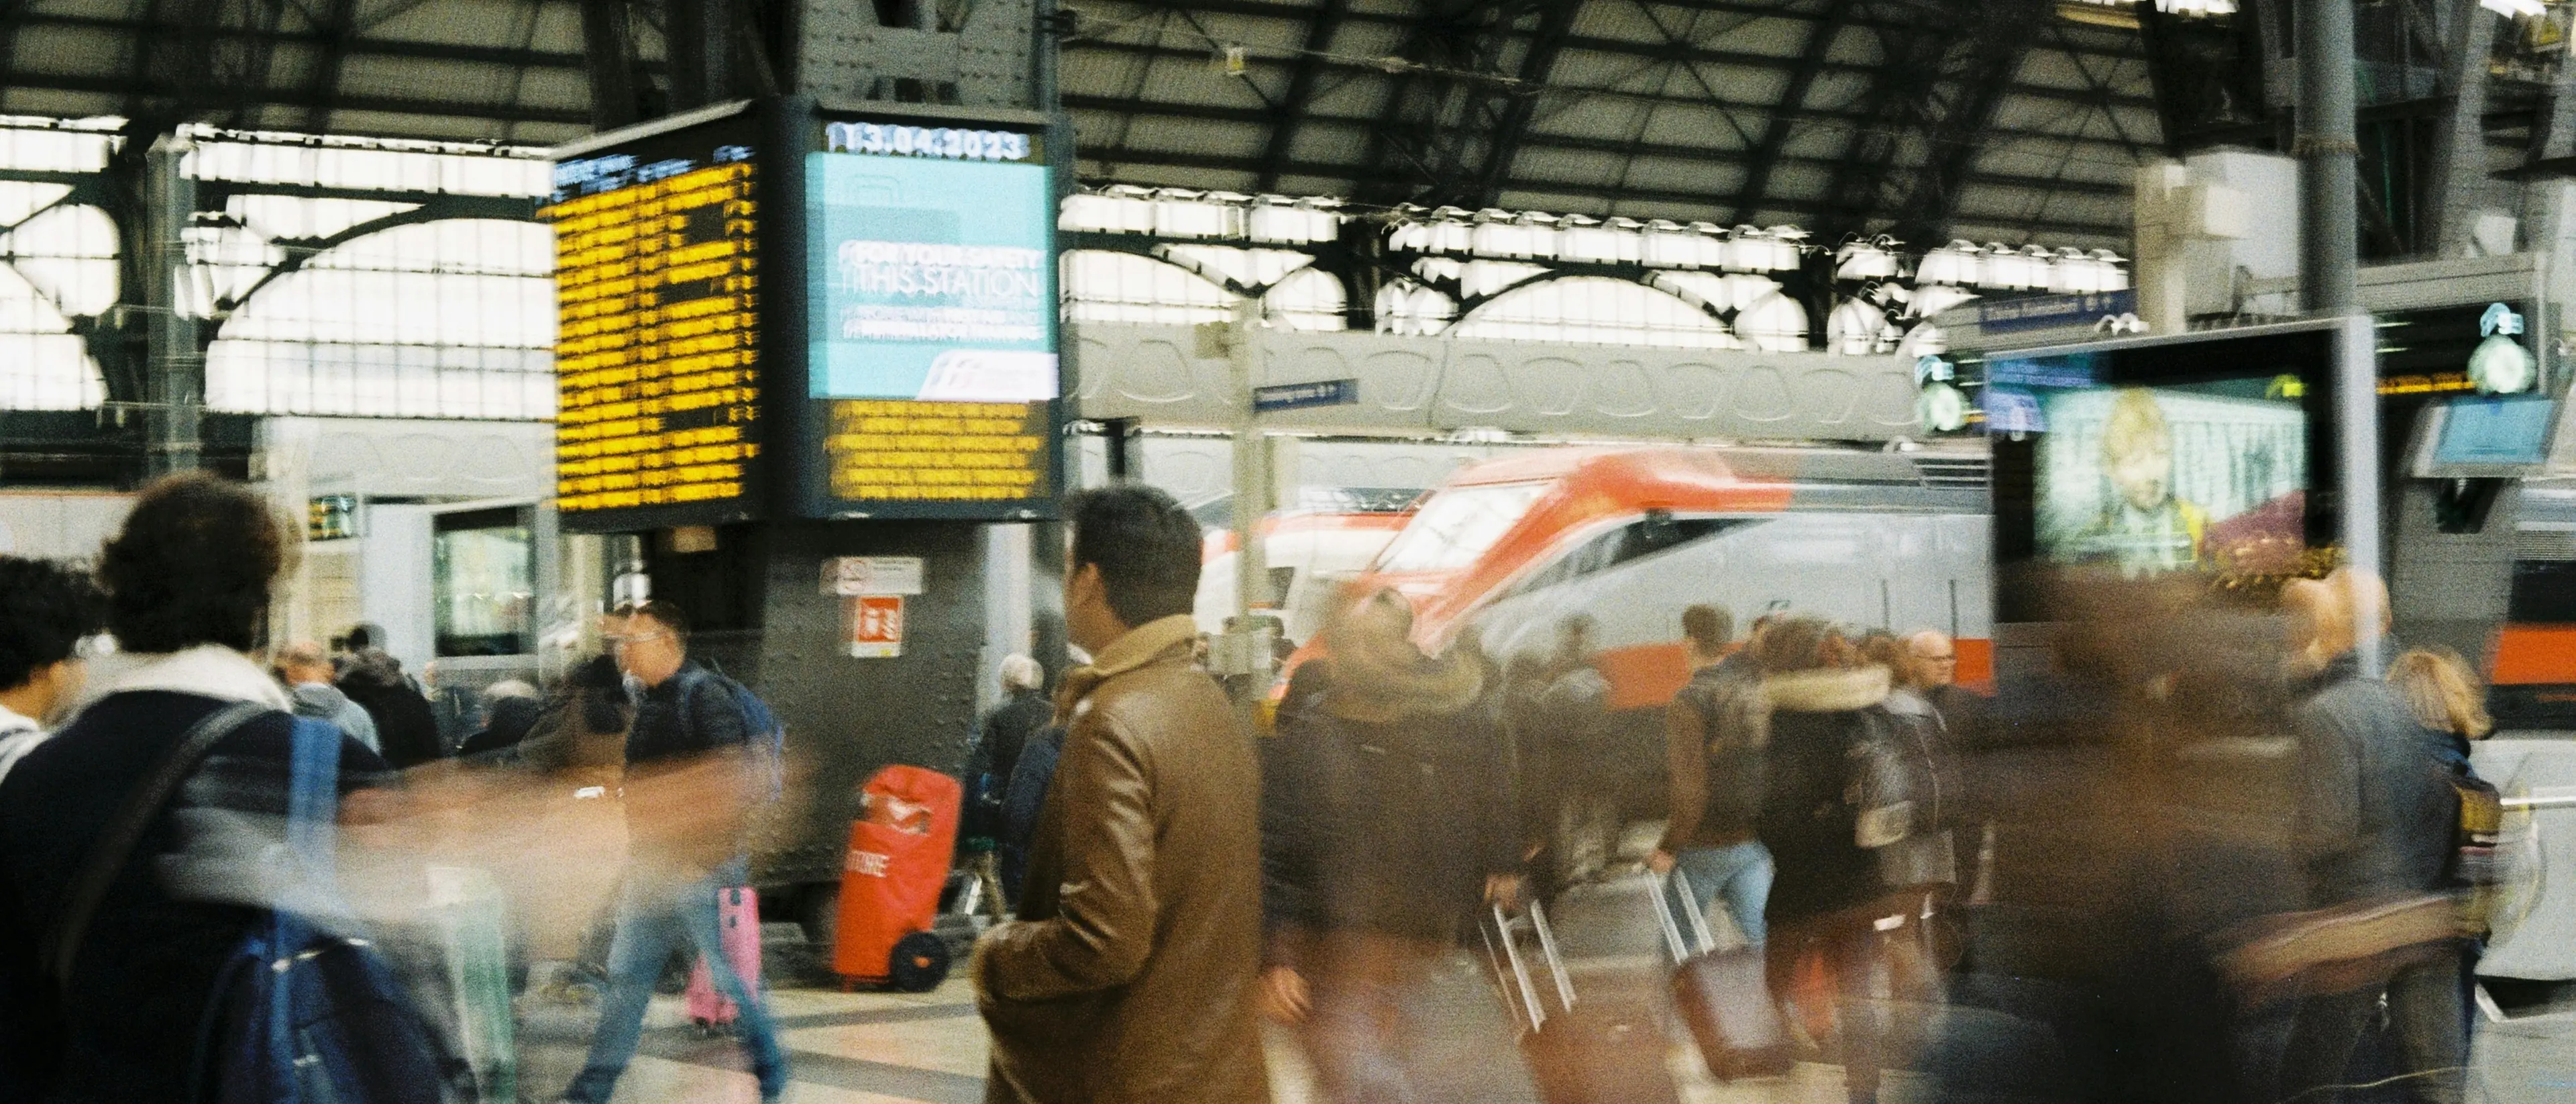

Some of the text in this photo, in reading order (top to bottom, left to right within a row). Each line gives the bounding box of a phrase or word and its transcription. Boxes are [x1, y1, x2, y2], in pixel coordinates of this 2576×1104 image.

[826, 122, 1030, 160] 13.04.2023
[900, 242, 962, 267] YOUR
[851, 265, 1040, 298] THIS STATION
